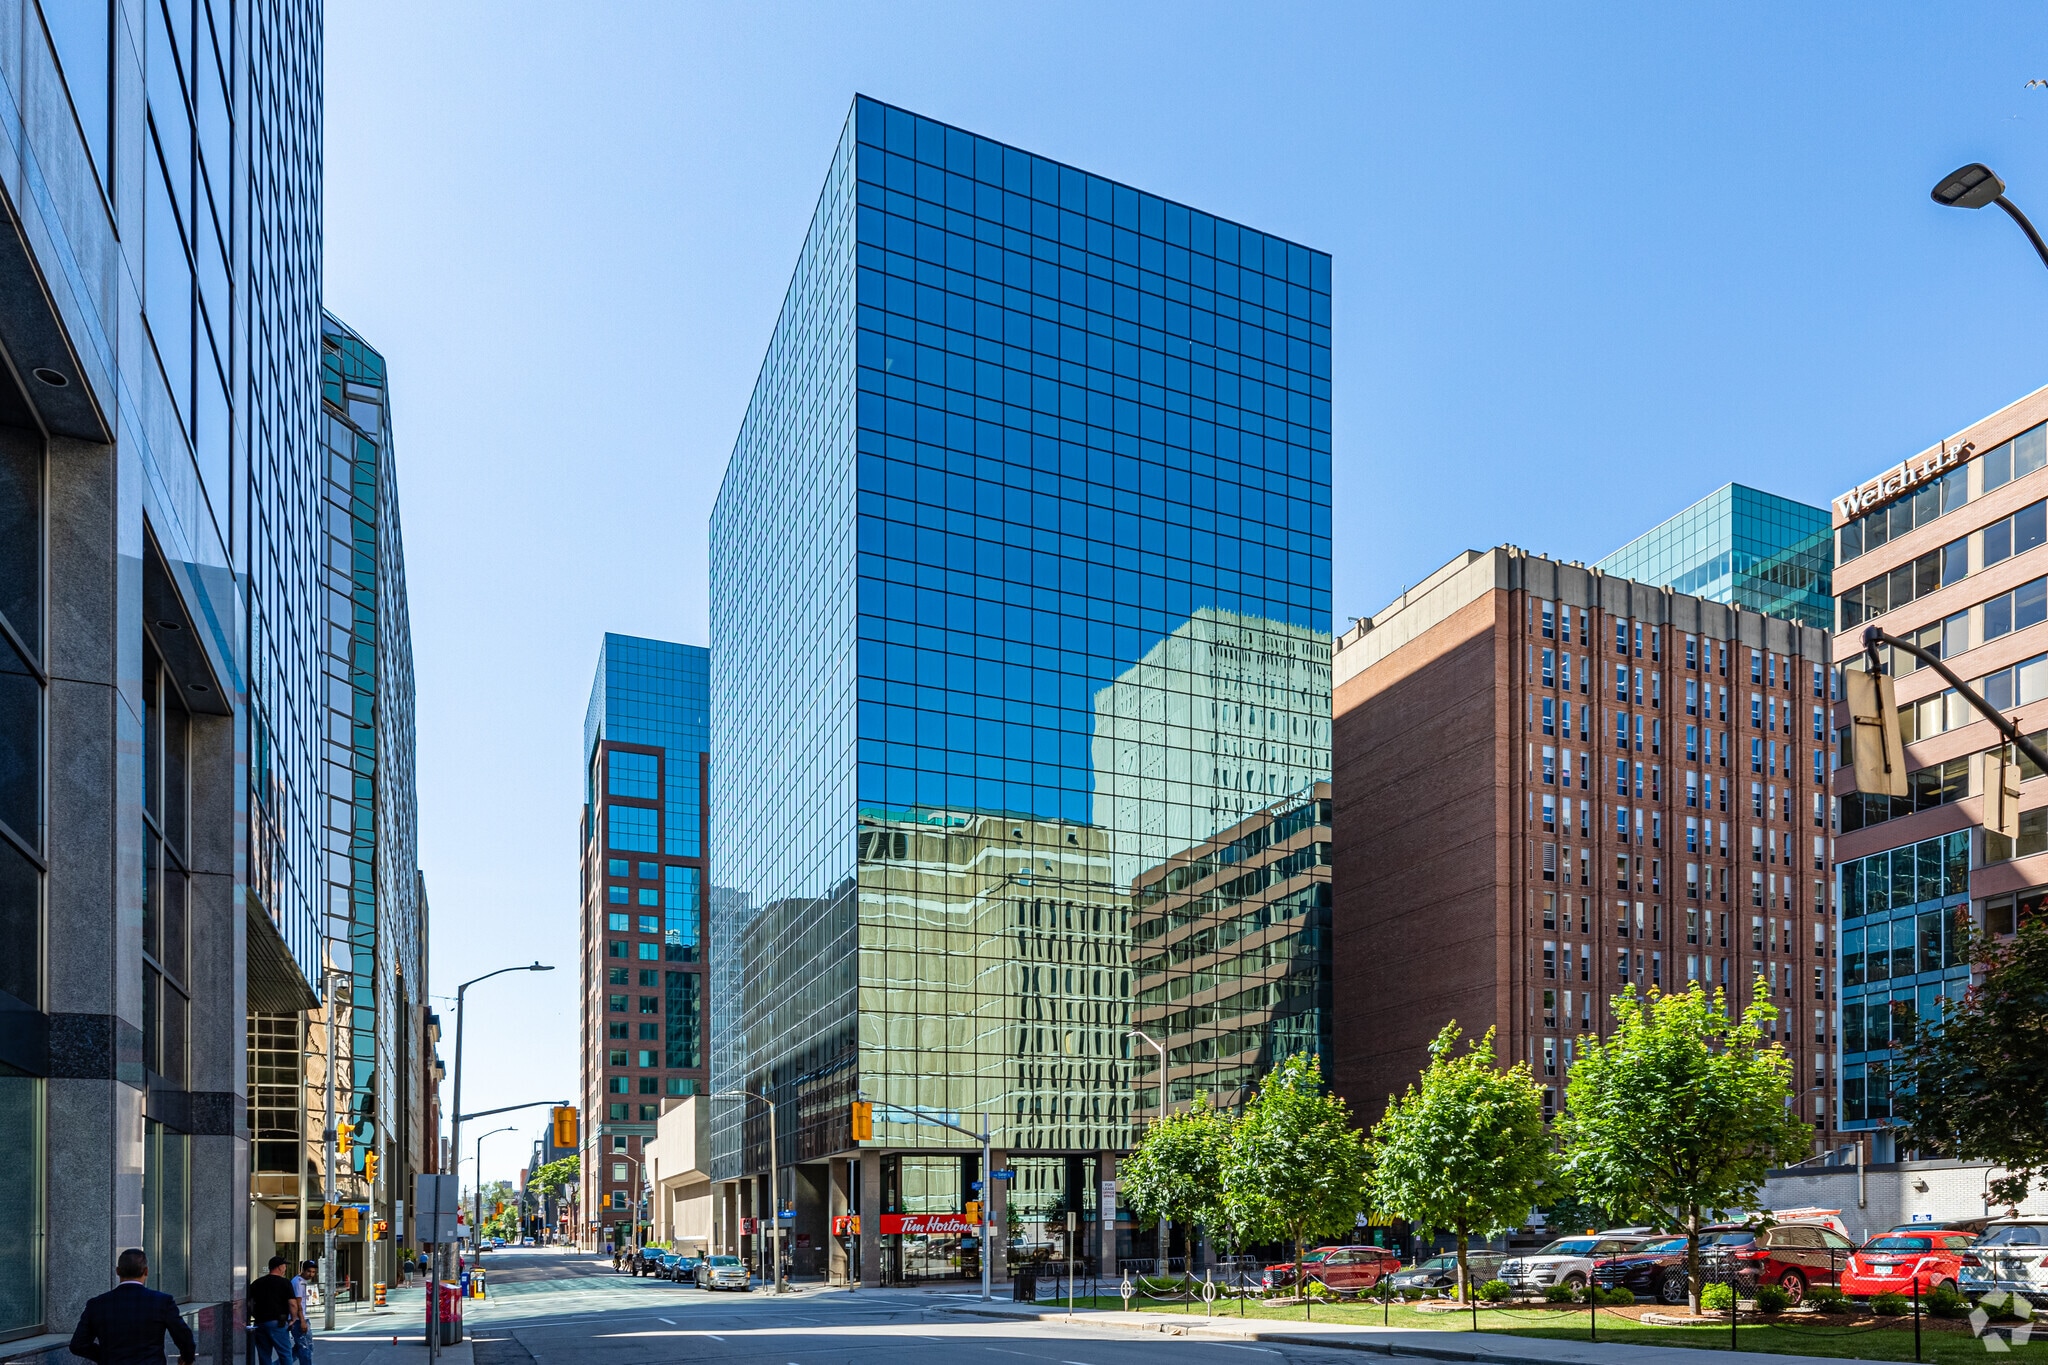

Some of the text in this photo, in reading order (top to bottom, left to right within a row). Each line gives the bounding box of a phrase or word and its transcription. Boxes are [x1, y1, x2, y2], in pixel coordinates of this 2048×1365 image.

[1837, 461, 1918, 518] Welch
[900, 1215, 973, 1233] Tim Hortons
